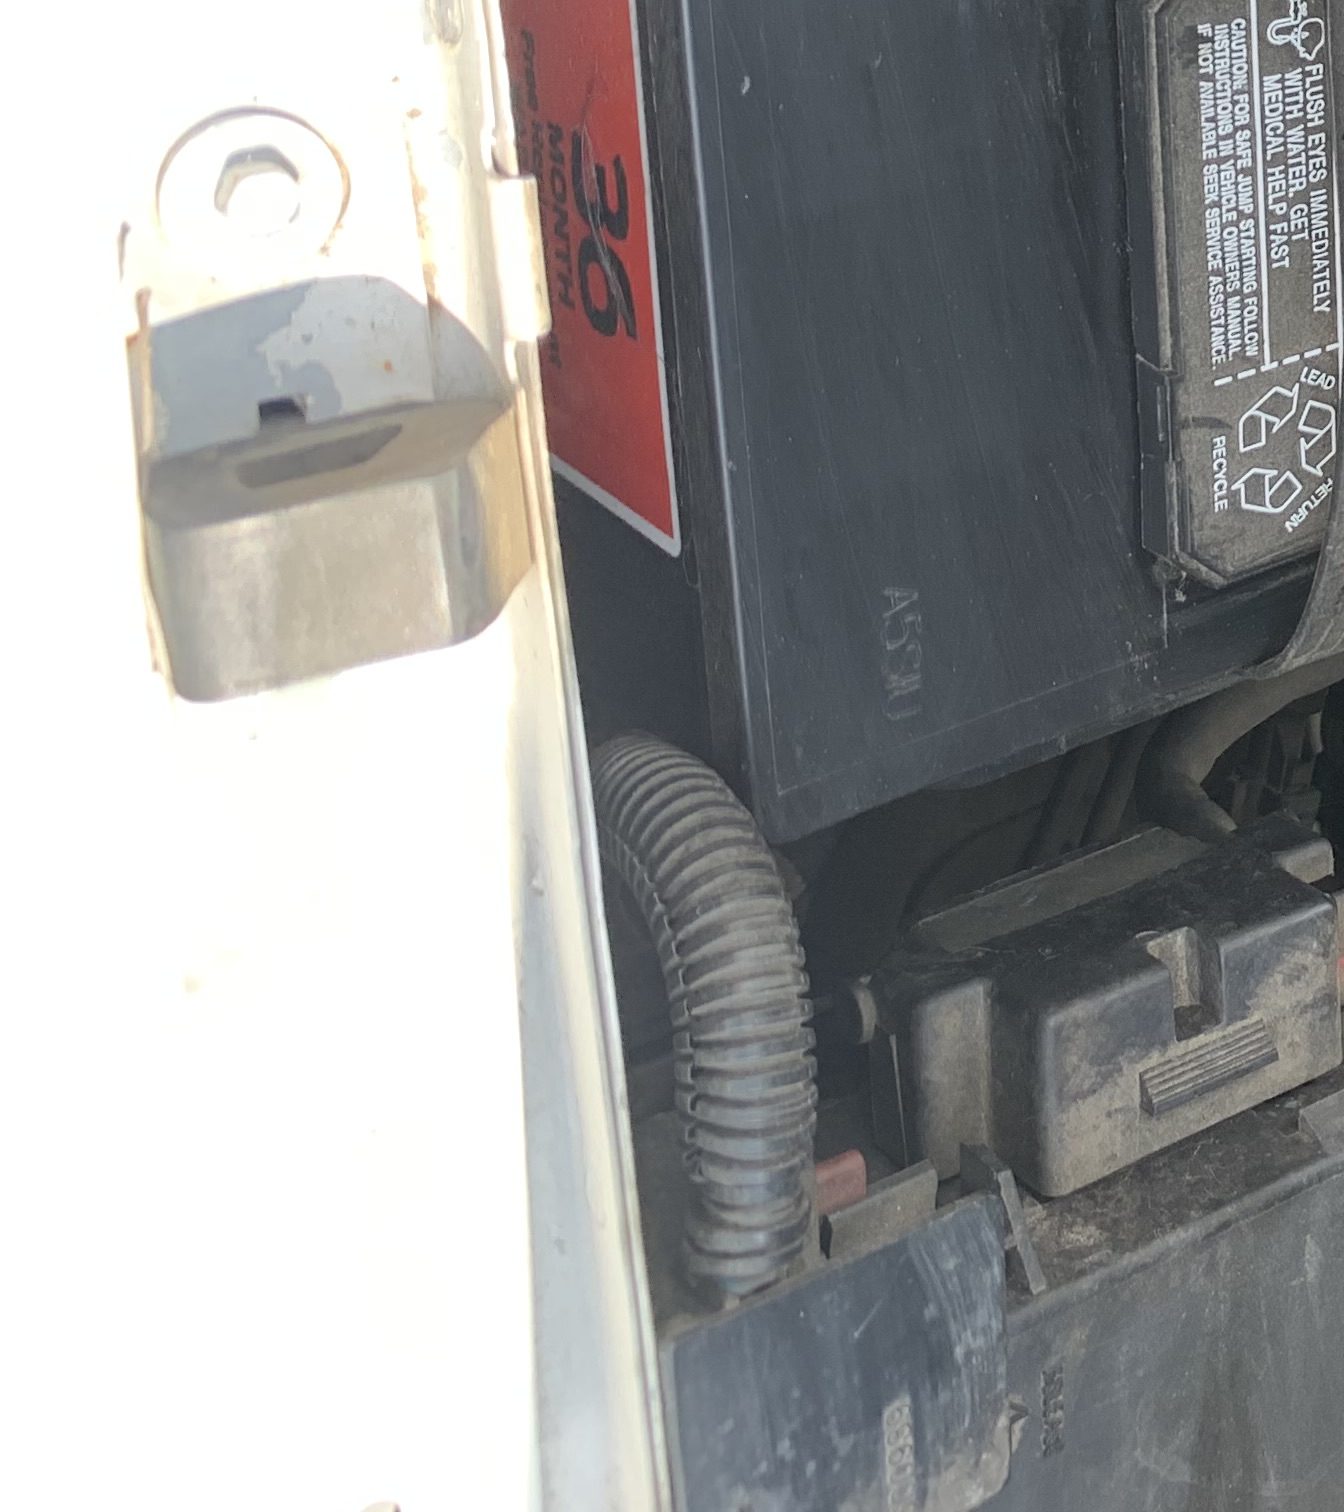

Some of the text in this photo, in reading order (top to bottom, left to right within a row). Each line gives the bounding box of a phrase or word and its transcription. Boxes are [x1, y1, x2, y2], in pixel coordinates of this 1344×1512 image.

[546, 120, 576, 311] MONTH
[571, 125, 638, 343] 36
[1196, 24, 1226, 370] IF NOT AVAILABLE SEEK SERVICE ASSISTANCE.
[1214, 24, 1243, 361] INSTRUCTIONS IN VEHICLE OWNERS MANUAL.
[1230, 18, 1259, 357] CAUTION: FOR SAFE JUMP STARTING FOLLOW
[1262, 74, 1290, 270] MEDICAL HELP FAST
[1283, 68, 1309, 241] WITH WATER. GET
[1304, 64, 1331, 314] FLUSH EYES IMMEDIATELY
[1212, 436, 1228, 512] RECYCLE
[1299, 366, 1336, 390] LEAD
[1283, 476, 1334, 534] RETURN
